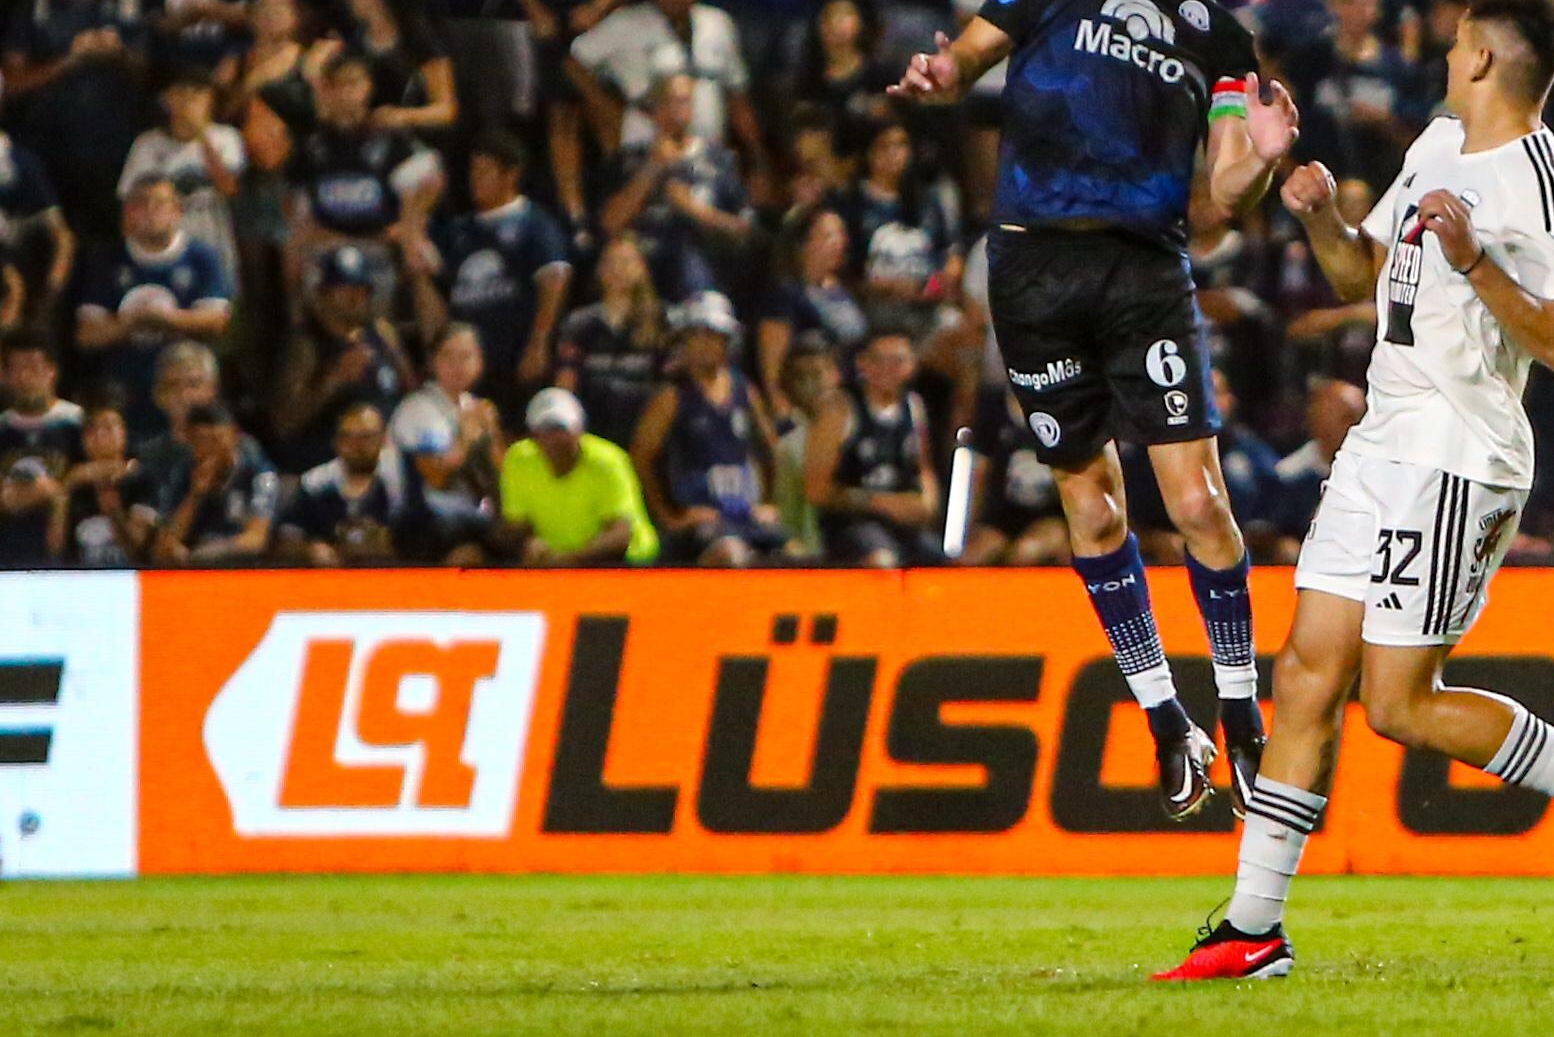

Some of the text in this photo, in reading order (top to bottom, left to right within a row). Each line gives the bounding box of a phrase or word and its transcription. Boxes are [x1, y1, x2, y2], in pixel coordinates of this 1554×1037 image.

[1074, 19, 1185, 84] Macro
[1146, 339, 1187, 387] 6
[1370, 529, 1423, 586] 32
